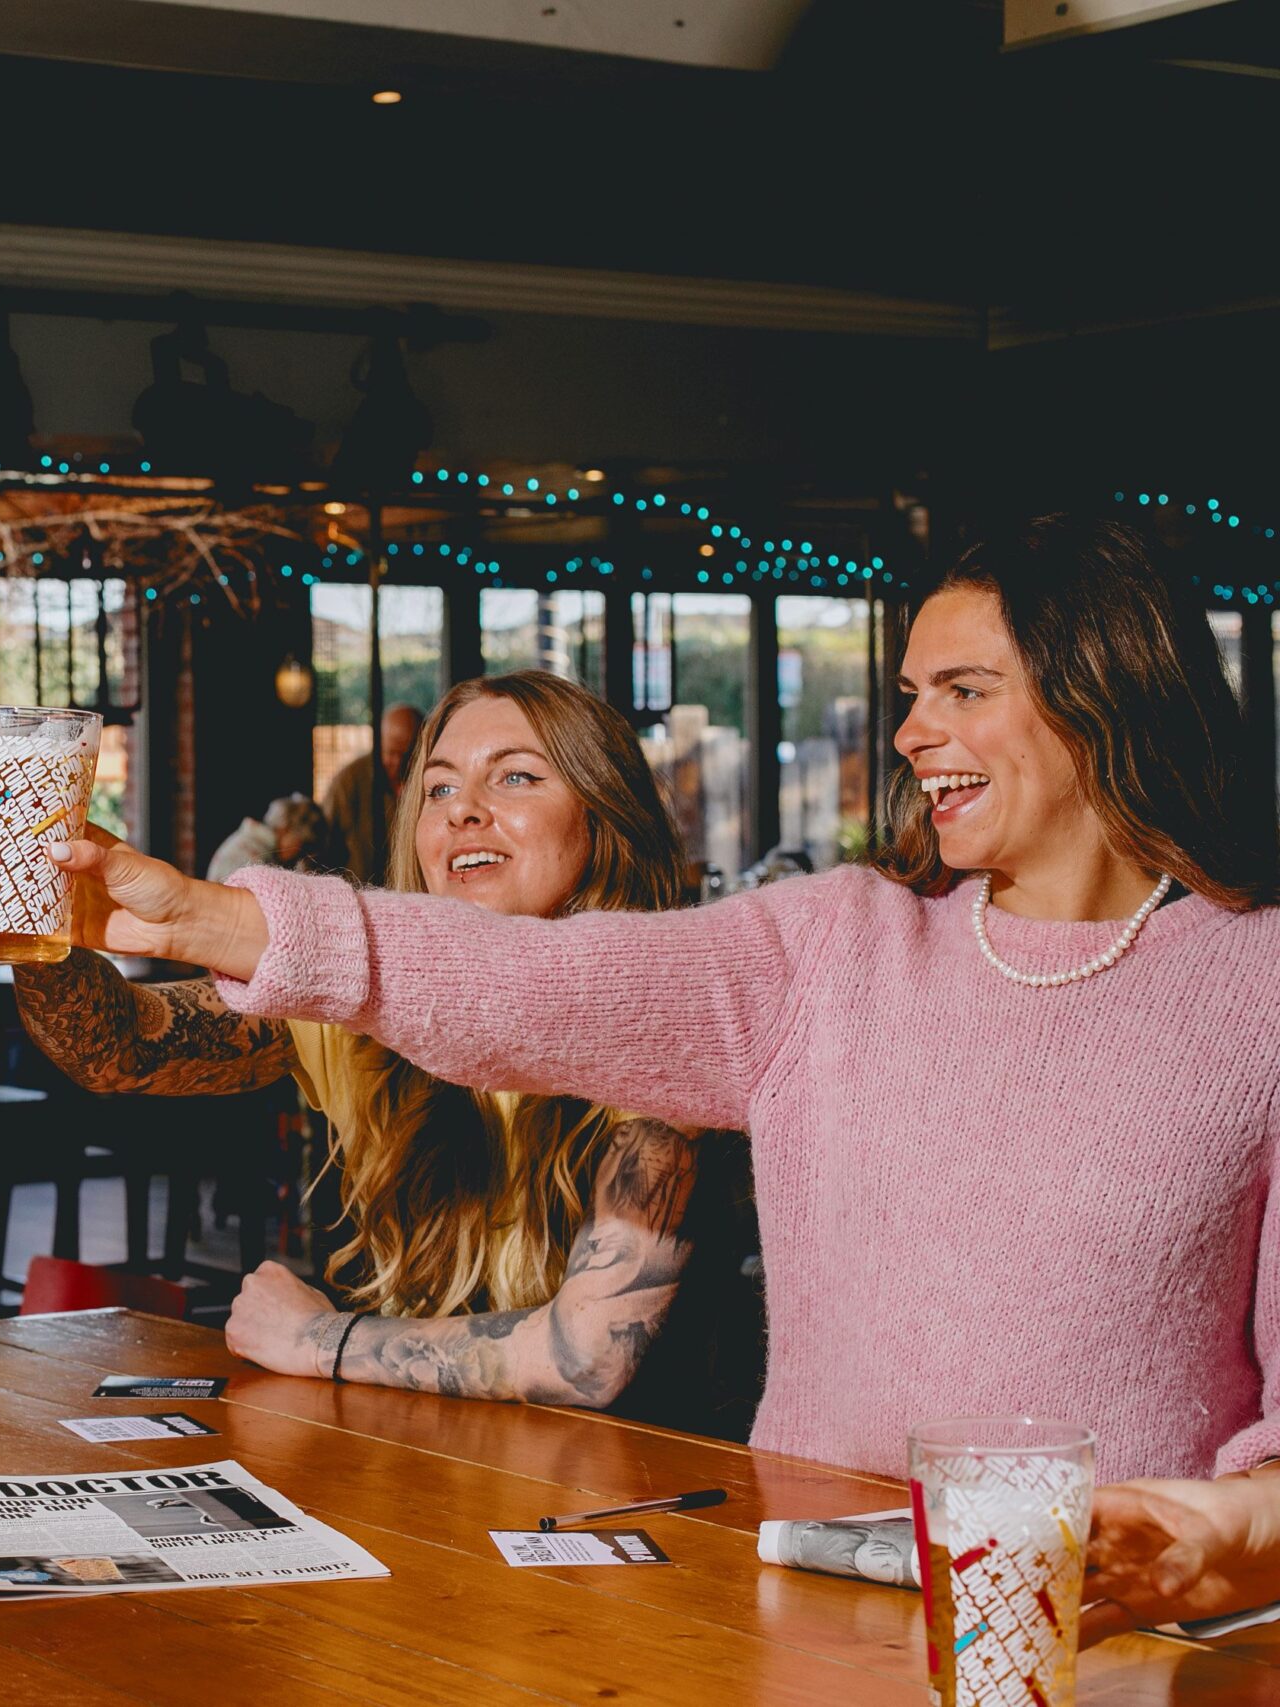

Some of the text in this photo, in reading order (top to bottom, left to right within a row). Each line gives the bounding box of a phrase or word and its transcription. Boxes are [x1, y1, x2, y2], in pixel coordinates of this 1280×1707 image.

[45, 1503, 88, 1512] OUT
[145, 1534, 205, 1544] WOMAN
[210, 1531, 255, 1540] TRIES
[150, 1535, 269, 1550] QUITE LIKES IT
[186, 1561, 351, 1581] DADS SET TO FIGHT?
